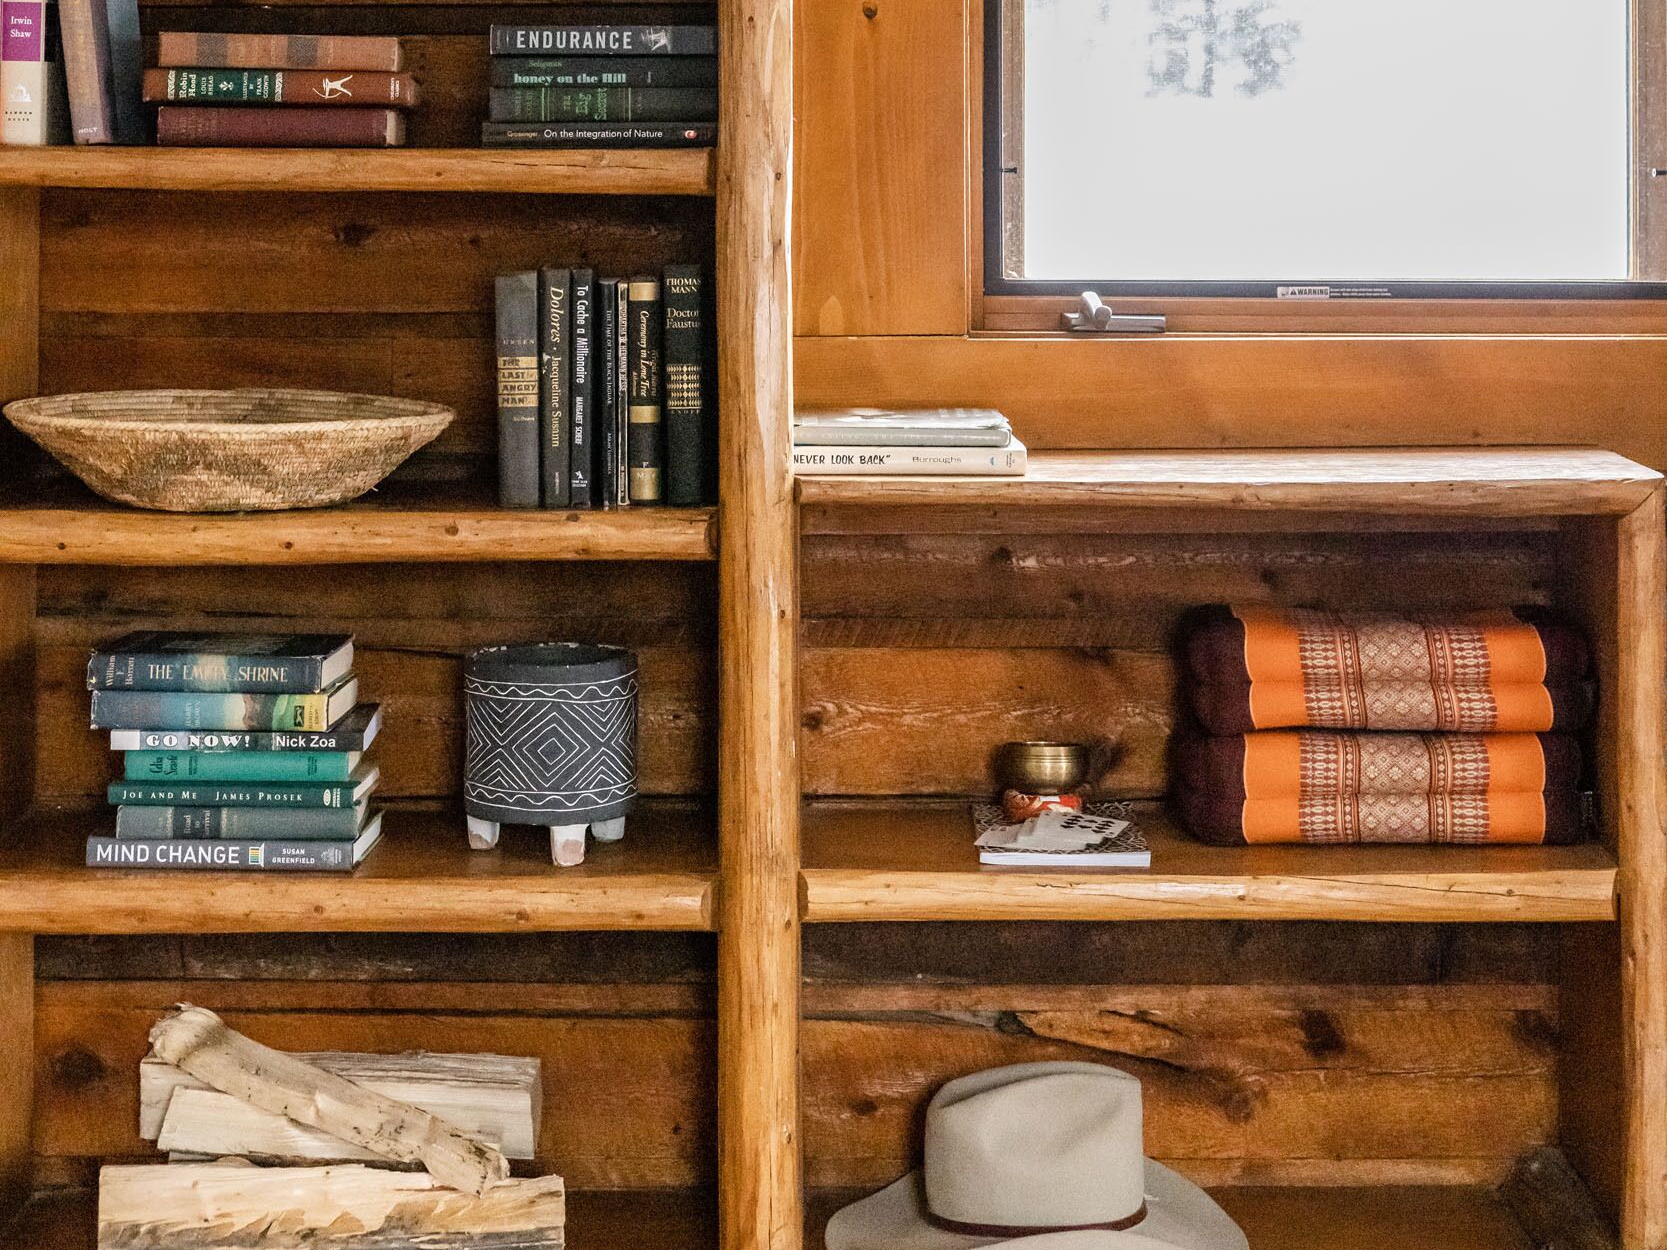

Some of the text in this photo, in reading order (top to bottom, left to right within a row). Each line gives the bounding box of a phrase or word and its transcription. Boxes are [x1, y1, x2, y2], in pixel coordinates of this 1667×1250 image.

[10, 16, 32, 25] Irwin
[10, 29, 31, 38] Shaw
[516, 31, 632, 49] ENDURANCE
[178, 72, 188, 99] Robin
[189, 74, 197, 97] Hood
[514, 73, 626, 86] honey on the Hill
[576, 93, 592, 115] Big
[594, 87, 607, 120] Secret
[544, 130, 558, 138] On
[560, 130, 574, 138] the
[576, 130, 622, 139] Integration
[623, 130, 632, 138] of
[634, 130, 663, 138] Nature
[666, 278, 701, 286] THOMAS
[577, 286, 588, 297] To
[1297, 288, 1329, 296] WARNING
[577, 300, 588, 325] Cache
[667, 308, 699, 318] Doctor
[606, 339, 612, 347] OF
[576, 337, 588, 384] Millionaire
[638, 310, 652, 397] Ceremony in Lone Tree
[502, 358, 520, 366] THE
[549, 287, 564, 447] Dolores Jacqueline Susann
[502, 384, 536, 392] ANGRY
[574, 397, 583, 445] MARGARET SCHERF
[793, 454, 826, 465] NEVER
[831, 454, 855, 465] LOOK
[912, 456, 962, 464] Burroughs
[105, 655, 116, 686] William
[148, 664, 288, 682] THE EMPTY SHRINE
[146, 734, 336, 748] GO NOW! Nick Zoa
[122, 790, 143, 799] JOE
[182, 791, 197, 799] ME
[215, 791, 250, 801] JAMES
[259, 792, 303, 801] PROSEK
[96, 844, 240, 864] MIND CHANGE
